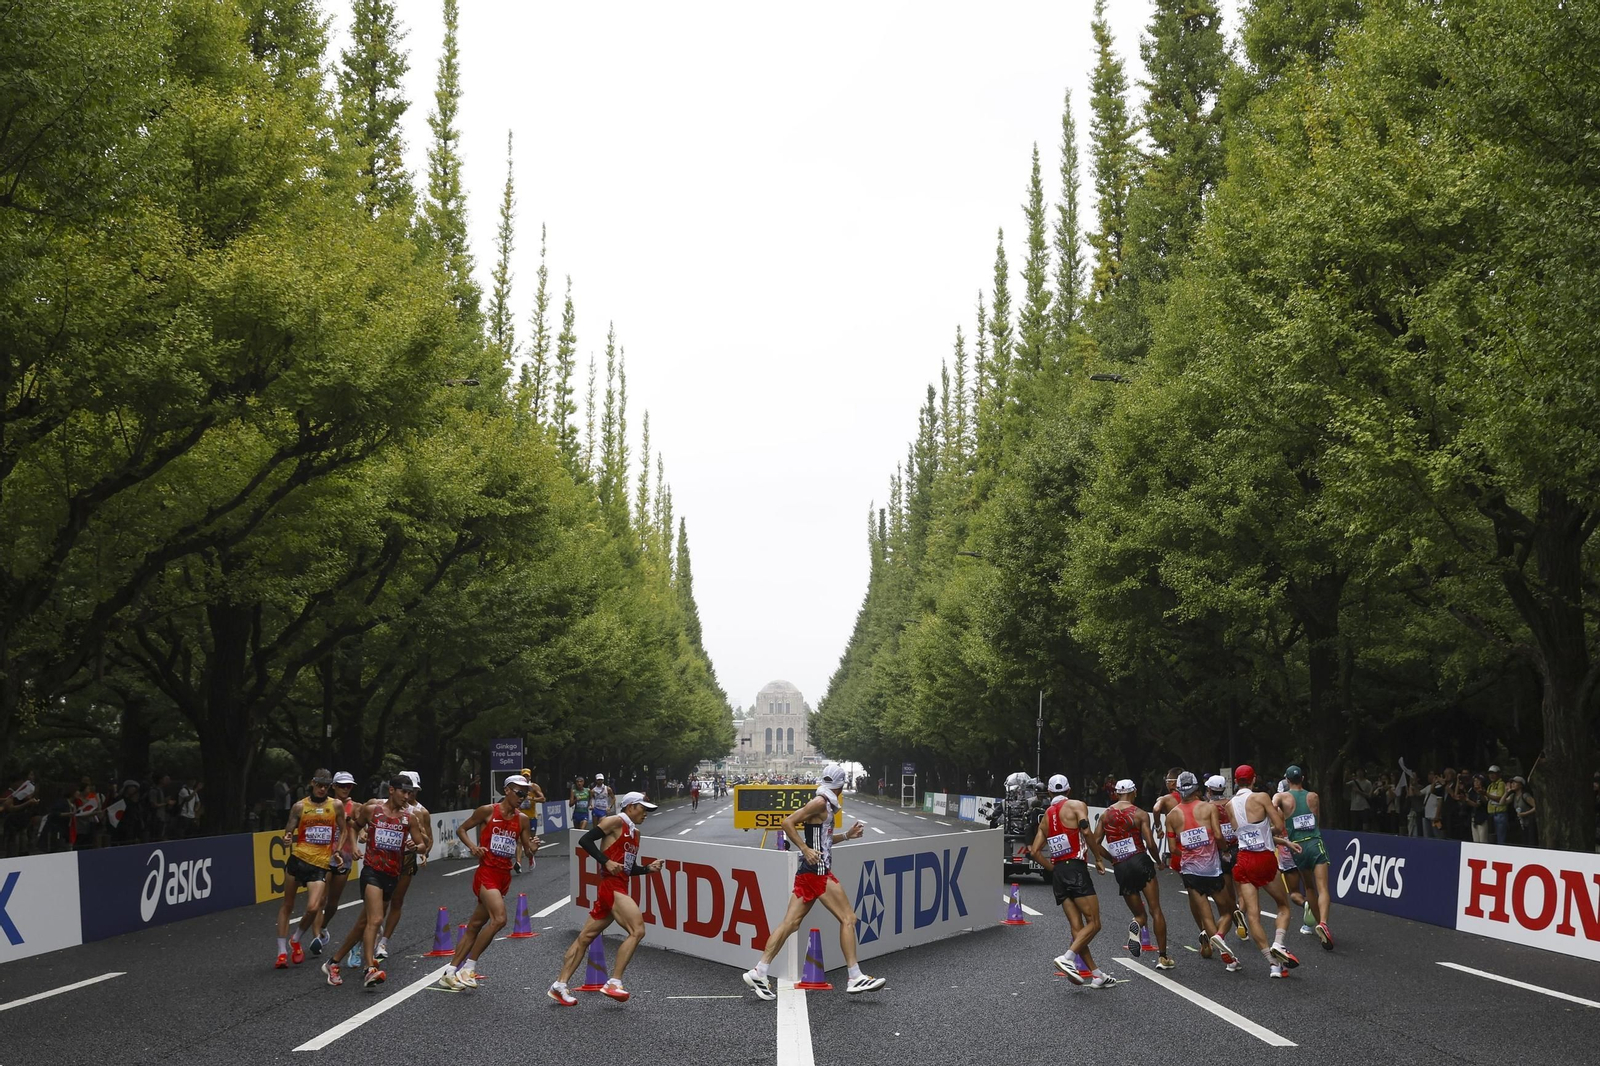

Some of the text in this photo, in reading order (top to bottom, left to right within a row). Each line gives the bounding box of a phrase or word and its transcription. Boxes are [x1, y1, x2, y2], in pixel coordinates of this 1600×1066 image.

[384, 829, 402, 838] TDK
[1186, 828, 1205, 836] TDK
[1242, 830, 1260, 839] TDK
[376, 835, 401, 845] SALAZAR
[500, 837, 515, 845] TDK
[1047, 834, 1066, 845] TDK
[1113, 838, 1131, 847] TDK
[1187, 835, 1202, 844] 355
[492, 842, 510, 852] WANG
[1115, 846, 1129, 855] 365
[1357, 853, 1406, 899] asics
[165, 857, 212, 906] asics
[884, 846, 969, 935] TDK
[575, 846, 771, 951] HNDA
